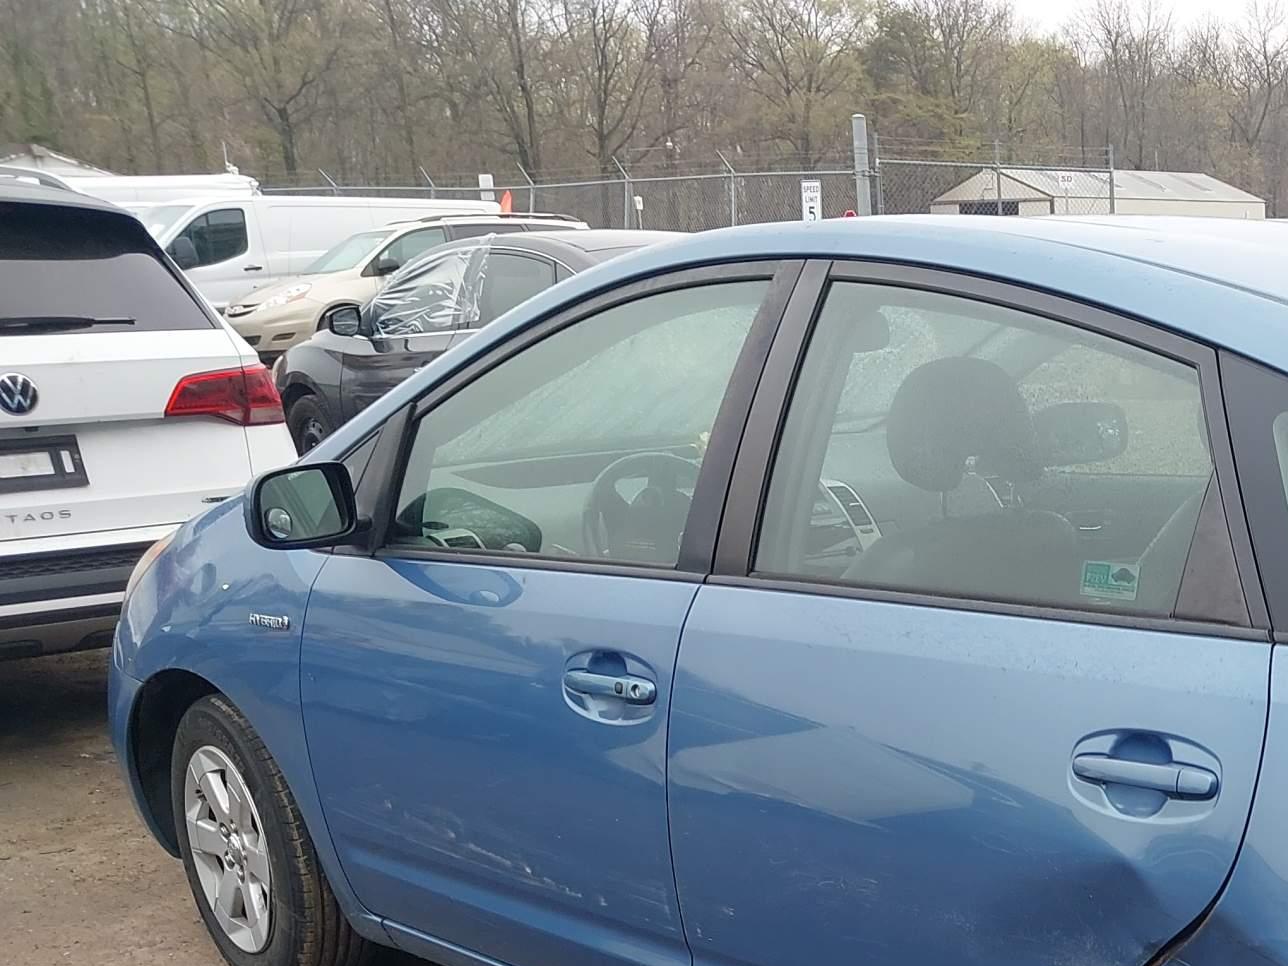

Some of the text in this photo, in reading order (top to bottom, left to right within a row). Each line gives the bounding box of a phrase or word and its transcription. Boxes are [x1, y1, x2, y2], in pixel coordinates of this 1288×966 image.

[803, 185, 819, 193] SPEED
[804, 195, 818, 203] LIMIT
[808, 206, 817, 221] 5
[4, 509, 72, 524] TAOS
